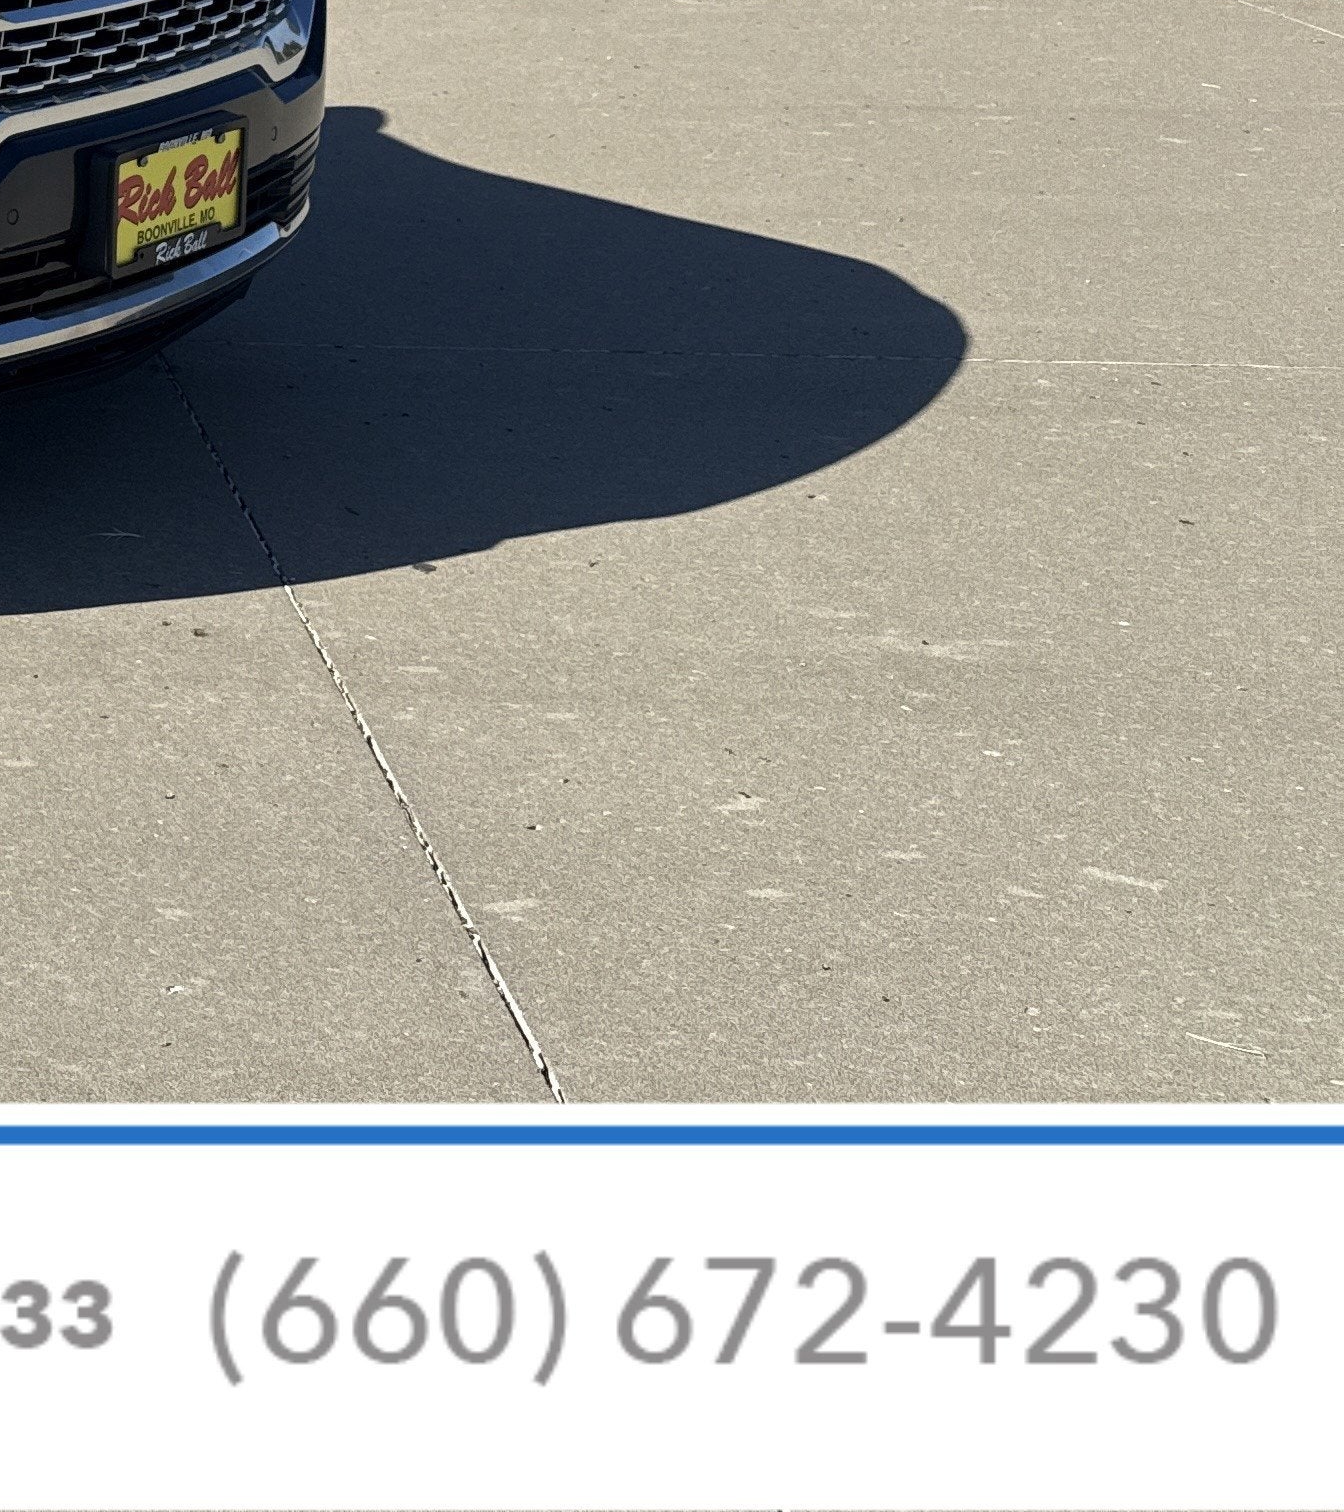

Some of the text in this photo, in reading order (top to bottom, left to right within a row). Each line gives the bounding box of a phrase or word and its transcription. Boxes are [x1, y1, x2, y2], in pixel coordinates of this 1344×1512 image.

[117, 148, 240, 226] Rick Ball
[200, 206, 216, 224] MO
[155, 230, 208, 265] Rick Ball
